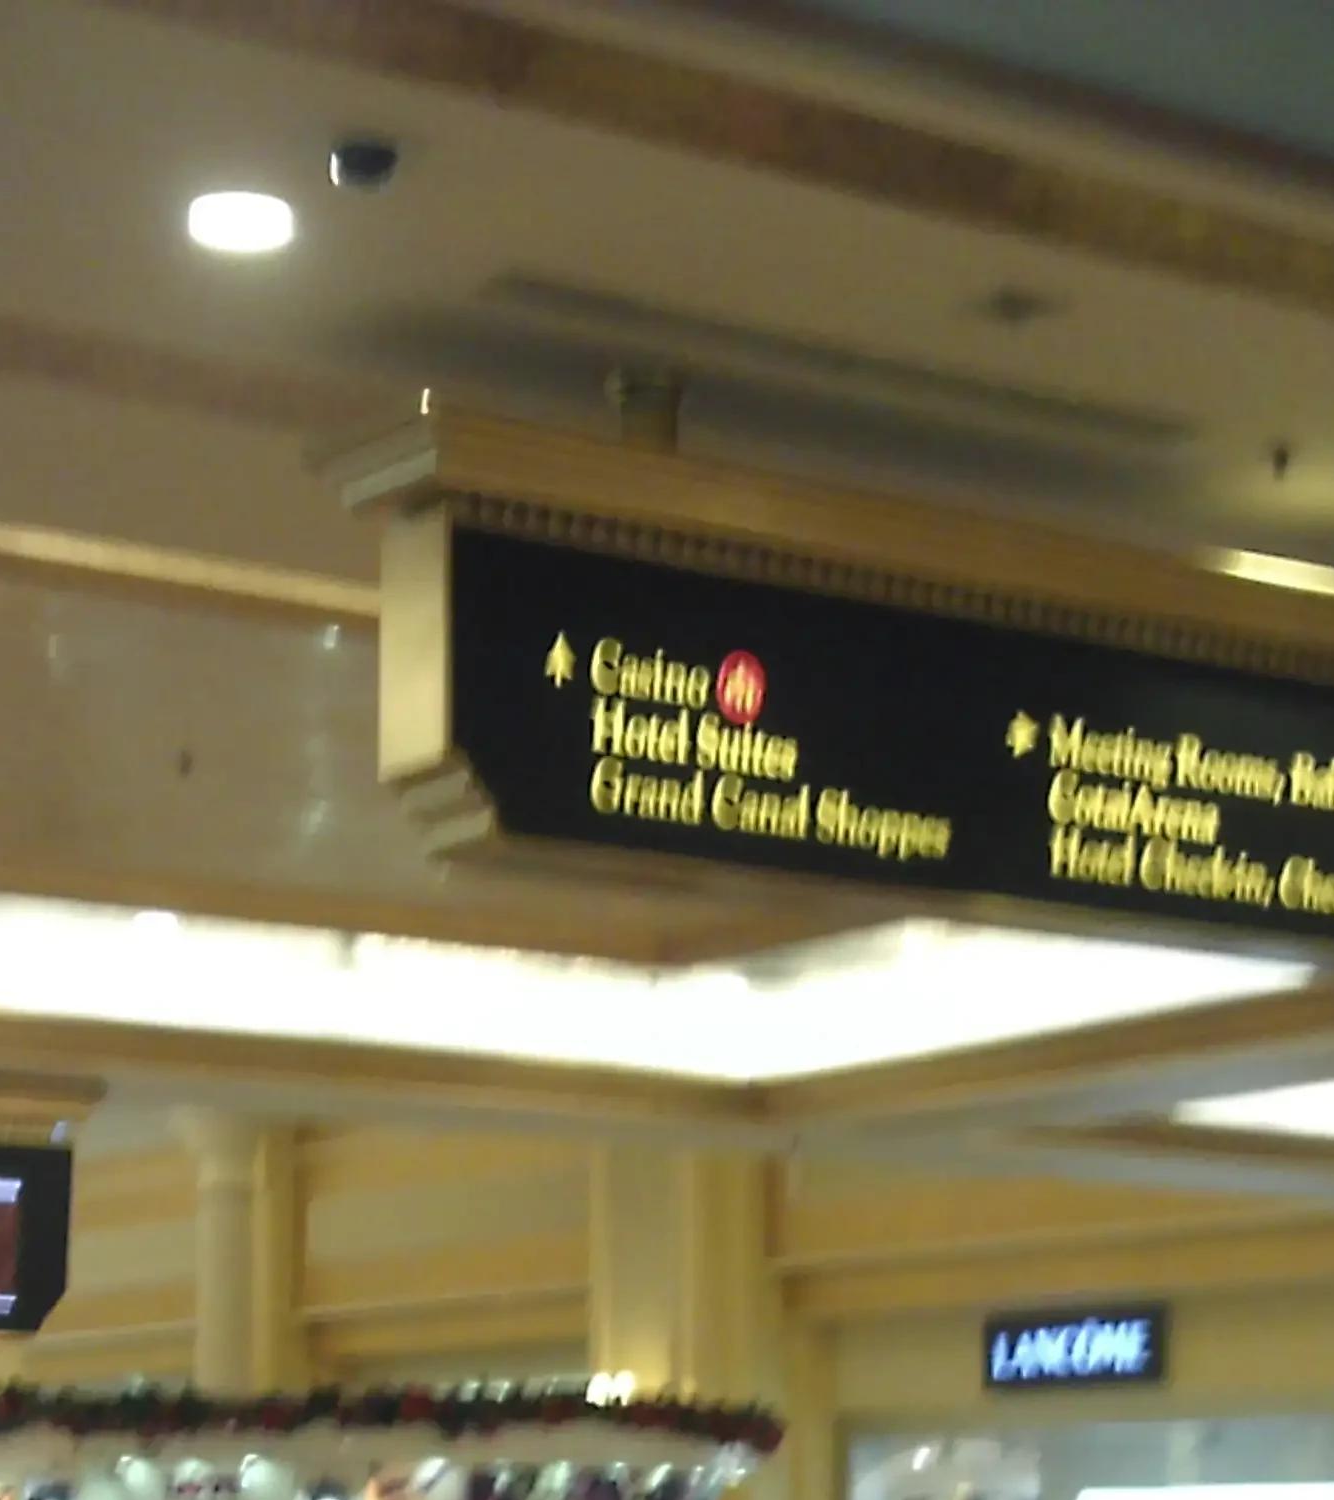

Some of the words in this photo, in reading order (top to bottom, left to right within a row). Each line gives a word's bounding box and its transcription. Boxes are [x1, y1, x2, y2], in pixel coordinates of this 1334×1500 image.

[591, 637, 711, 709] Casino
[592, 697, 688, 765] Hotel
[696, 711, 798, 781] Suites
[1050, 713, 1171, 788] Meeting
[1177, 733, 1285, 805] Rooms,
[590, 756, 704, 825] Grand
[712, 773, 809, 840] Canal
[816, 786, 952, 861] Shoppes
[1051, 826, 1135, 886] Hotel
